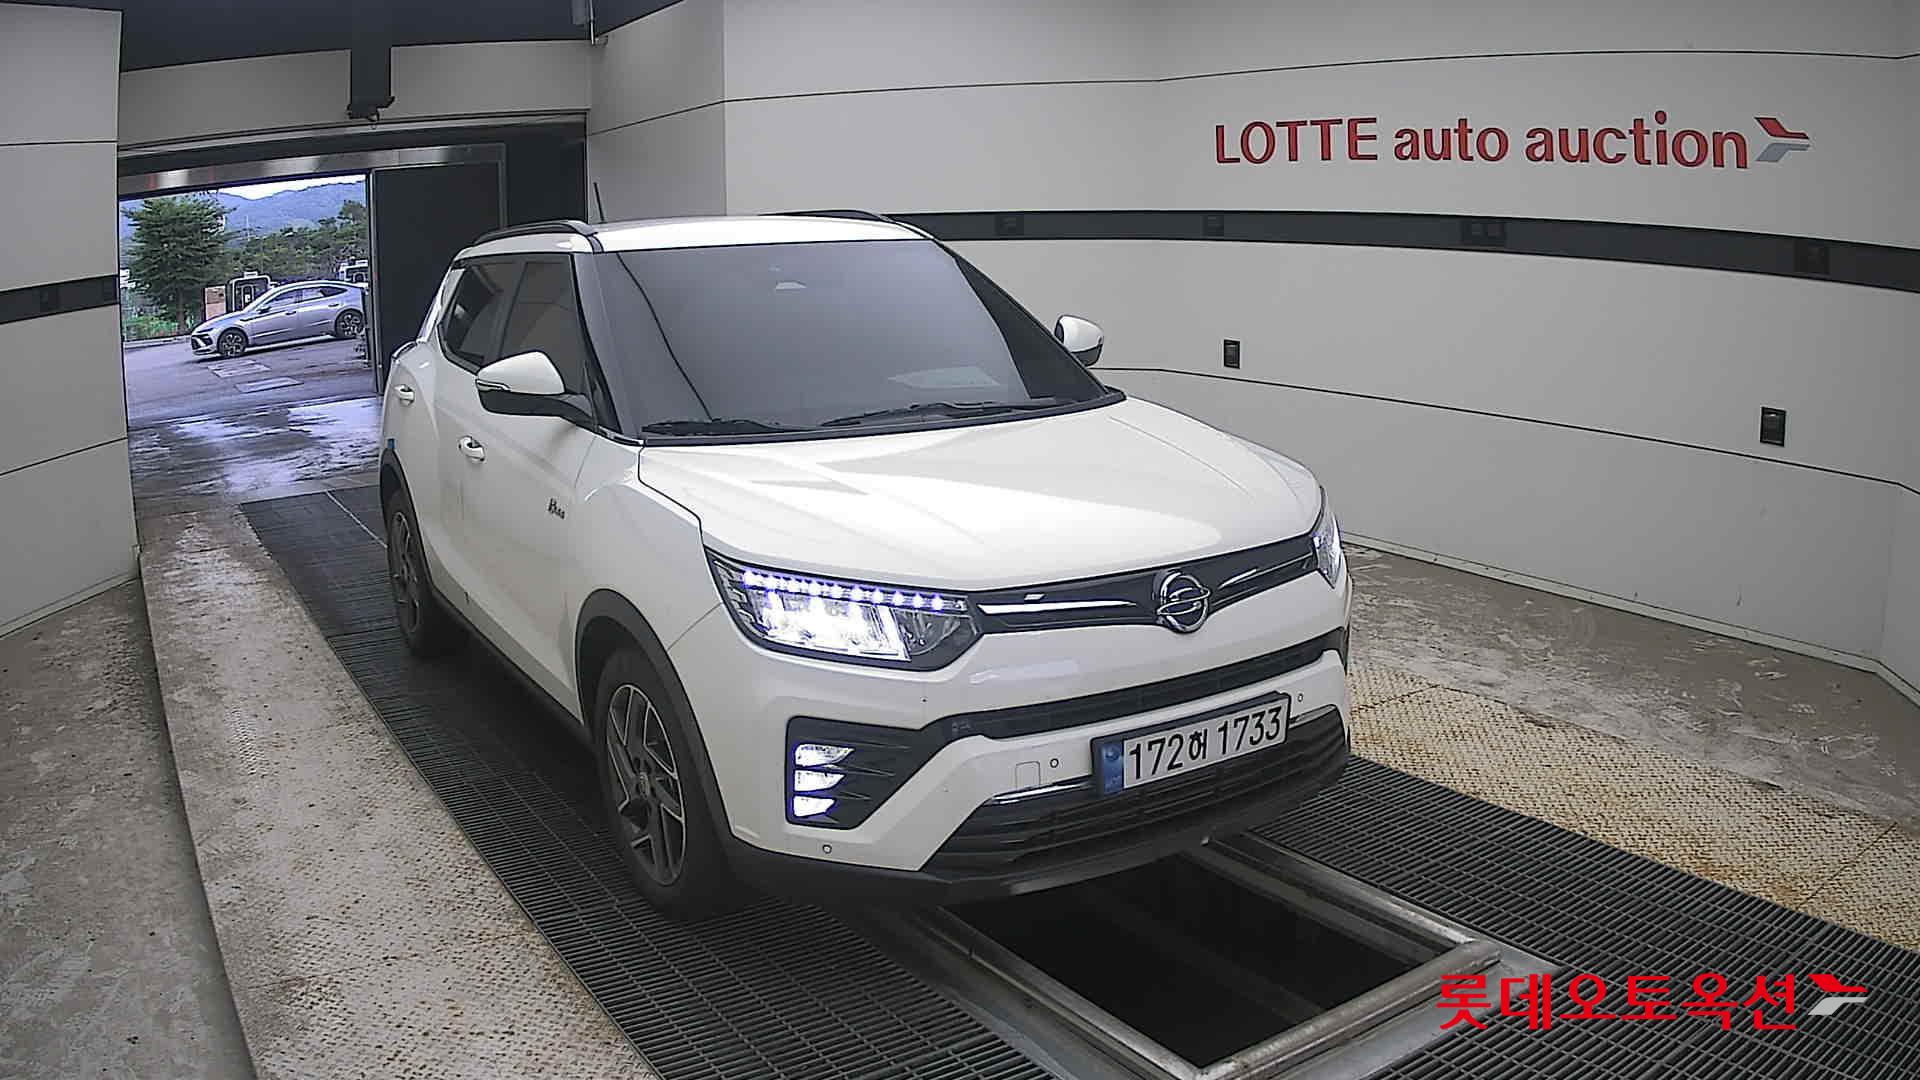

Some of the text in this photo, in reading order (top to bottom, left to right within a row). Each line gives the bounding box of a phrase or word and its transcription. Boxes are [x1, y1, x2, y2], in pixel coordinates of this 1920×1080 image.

[1215, 111, 1749, 168] LOTTE auto auction
[1129, 706, 1283, 780] 172허 1733
